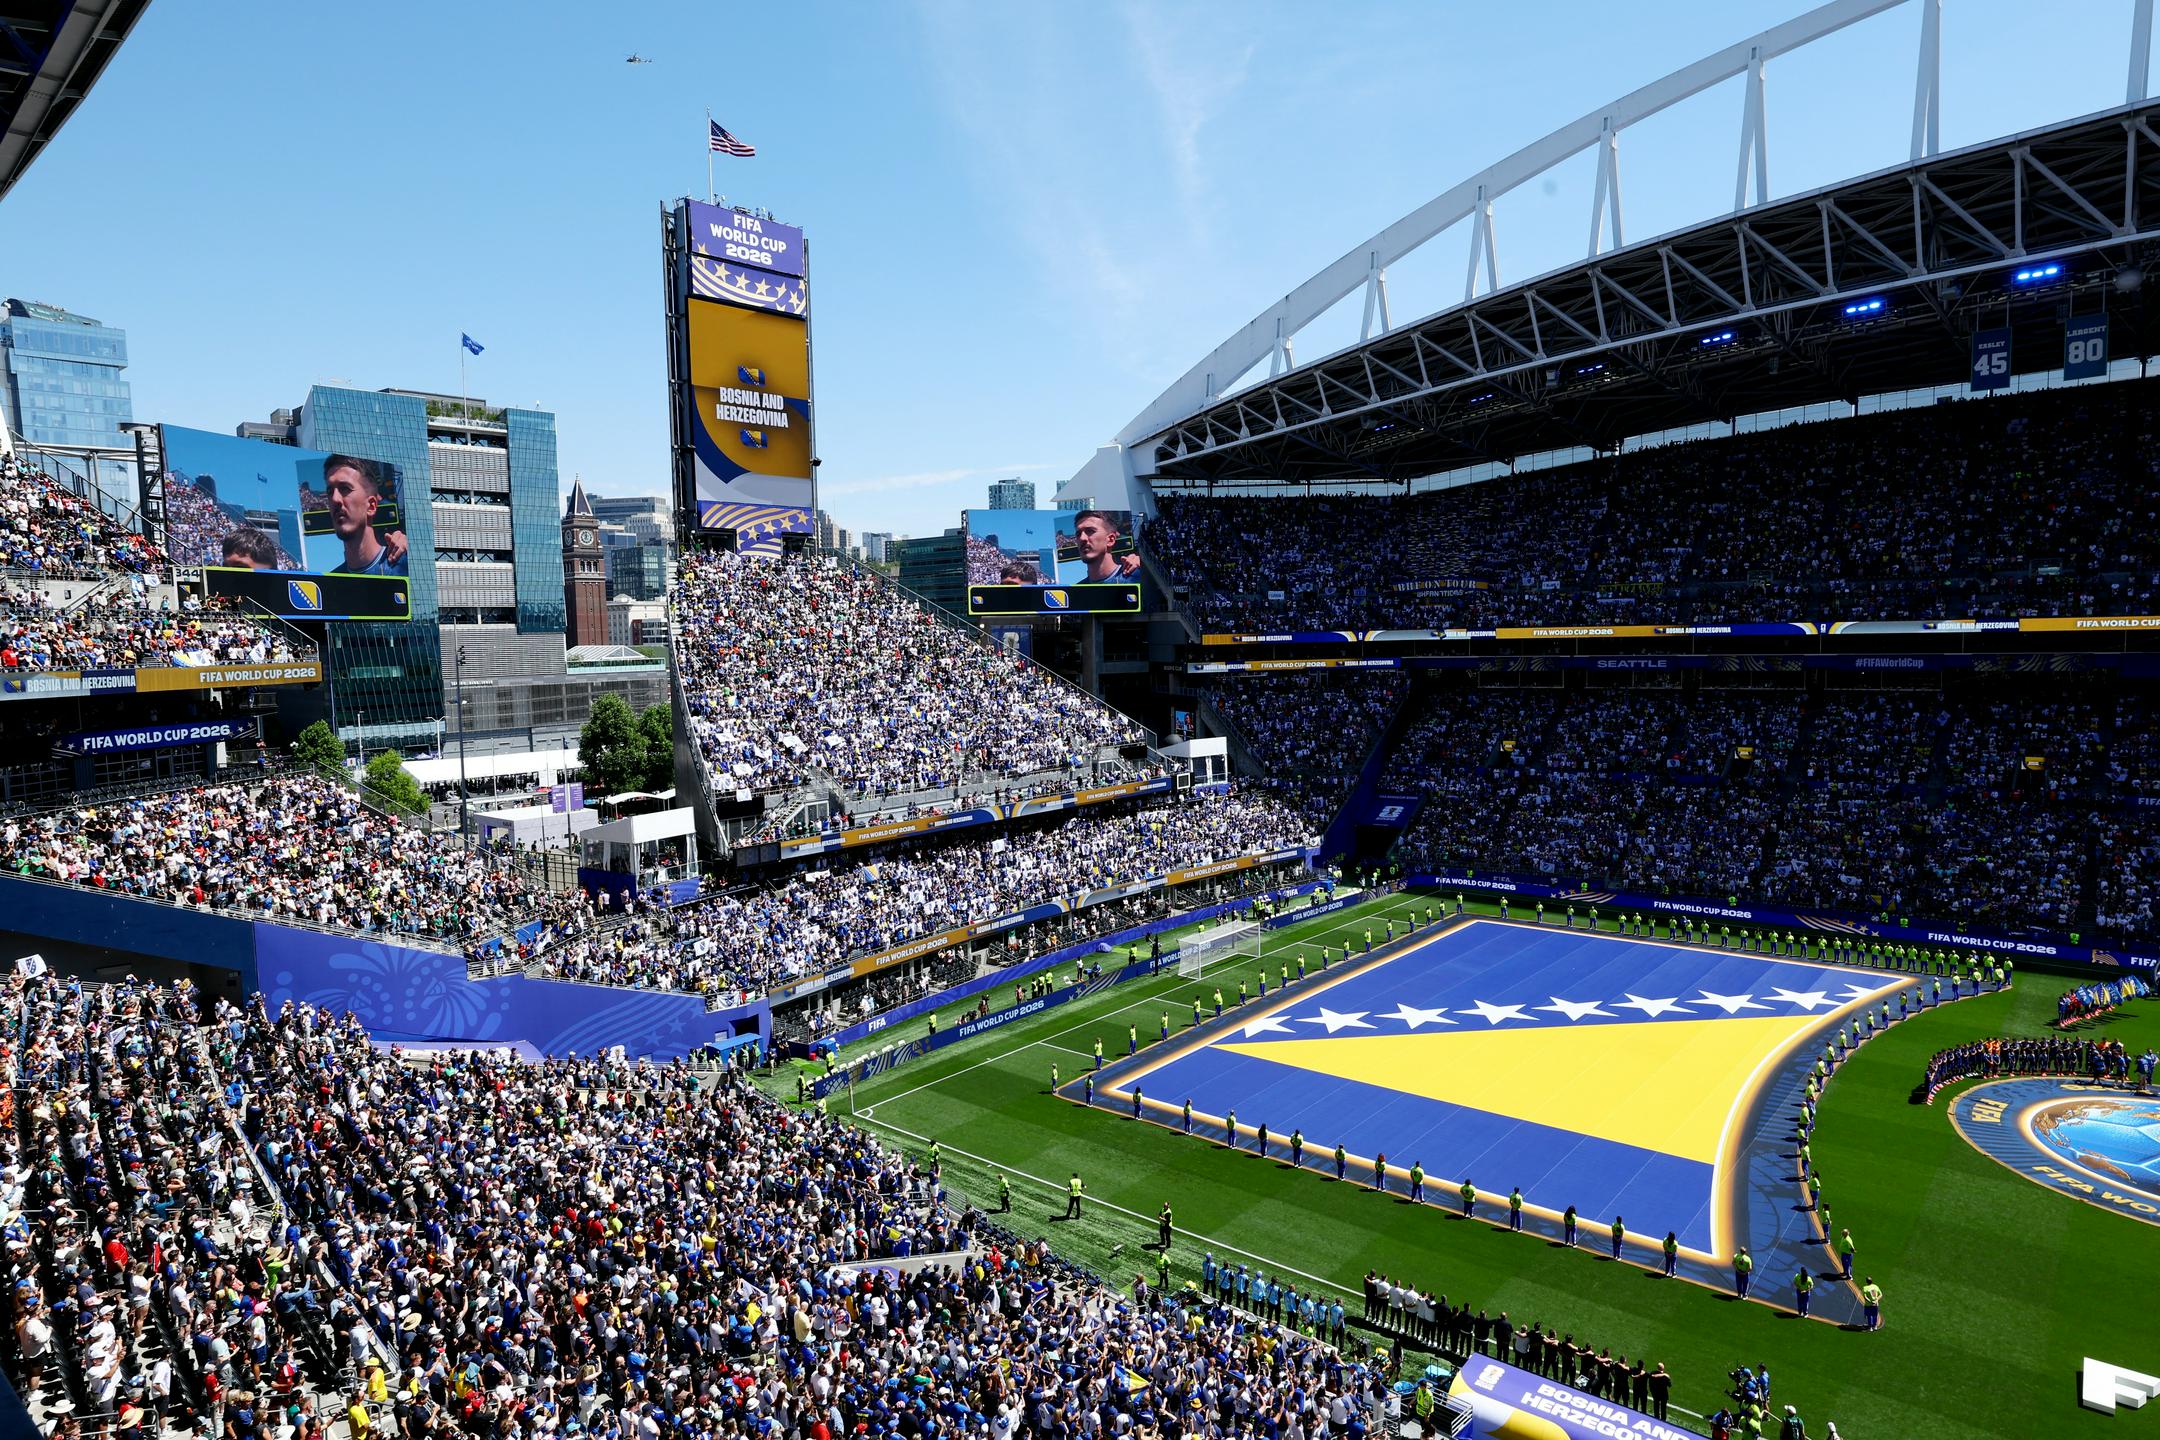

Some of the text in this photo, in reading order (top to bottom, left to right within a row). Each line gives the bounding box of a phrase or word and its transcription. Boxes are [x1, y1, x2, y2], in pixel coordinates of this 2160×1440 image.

[733, 214, 763, 234] FIFA
[709, 223, 787, 254] WORLD CUP
[725, 243, 773, 265] 2026
[2068, 338, 2104, 365] 80
[1973, 351, 2008, 376] 45
[719, 386, 784, 411] BOSNIA AND
[716, 403, 789, 428] HERZEGOVINA
[175, 568, 200, 578] 344
[1445, 579, 1477, 590] TOUR
[1937, 622, 1961, 630] BOSNIA
[1975, 621, 2020, 629] HERZEGOVINA
[2076, 620, 2099, 628] FIFA
[2099, 619, 2140, 627] WORLD
[1596, 659, 1668, 668] SEATTLE
[1855, 657, 1924, 669] #FIFAWorldCup
[27, 675, 137, 693] BOSNIA AND HERZEGOVINA
[200, 667, 317, 683] FIFA WORLD CUP 2026
[83, 724, 231, 751] FIFA WORLD CUP 2026
[858, 832, 870, 840] FIFA
[870, 831, 889, 839] WORLD
[1183, 862, 1239, 879] FIFA WORLD CUP 2026
[1435, 877, 1517, 891] FIFA WORLD CUP 2026
[1292, 913, 1303, 922] FIFA
[1302, 908, 1320, 918] WORLD
[1319, 905, 1329, 914] CUP
[1653, 901, 1752, 919] FIFA WORLD CUP 2026
[876, 936, 948, 966] FIFA WORLD CUP 2026
[1928, 933, 2057, 955] FIFA WORLD CUP 2026
[1149, 959, 1163, 969] FIA
[1162, 951, 1181, 965] WORLD
[1181, 947, 1193, 957] CUP
[2130, 956, 2157, 967] FIFA
[868, 1017, 887, 1032] FIFA
[959, 1000, 1045, 1038] FIFA WORLD CUP 2026
[1971, 1098, 2009, 1123] FIFA
[2031, 1166, 2095, 1194] FIFA
[1537, 1383, 1629, 1426] BOSNIA
